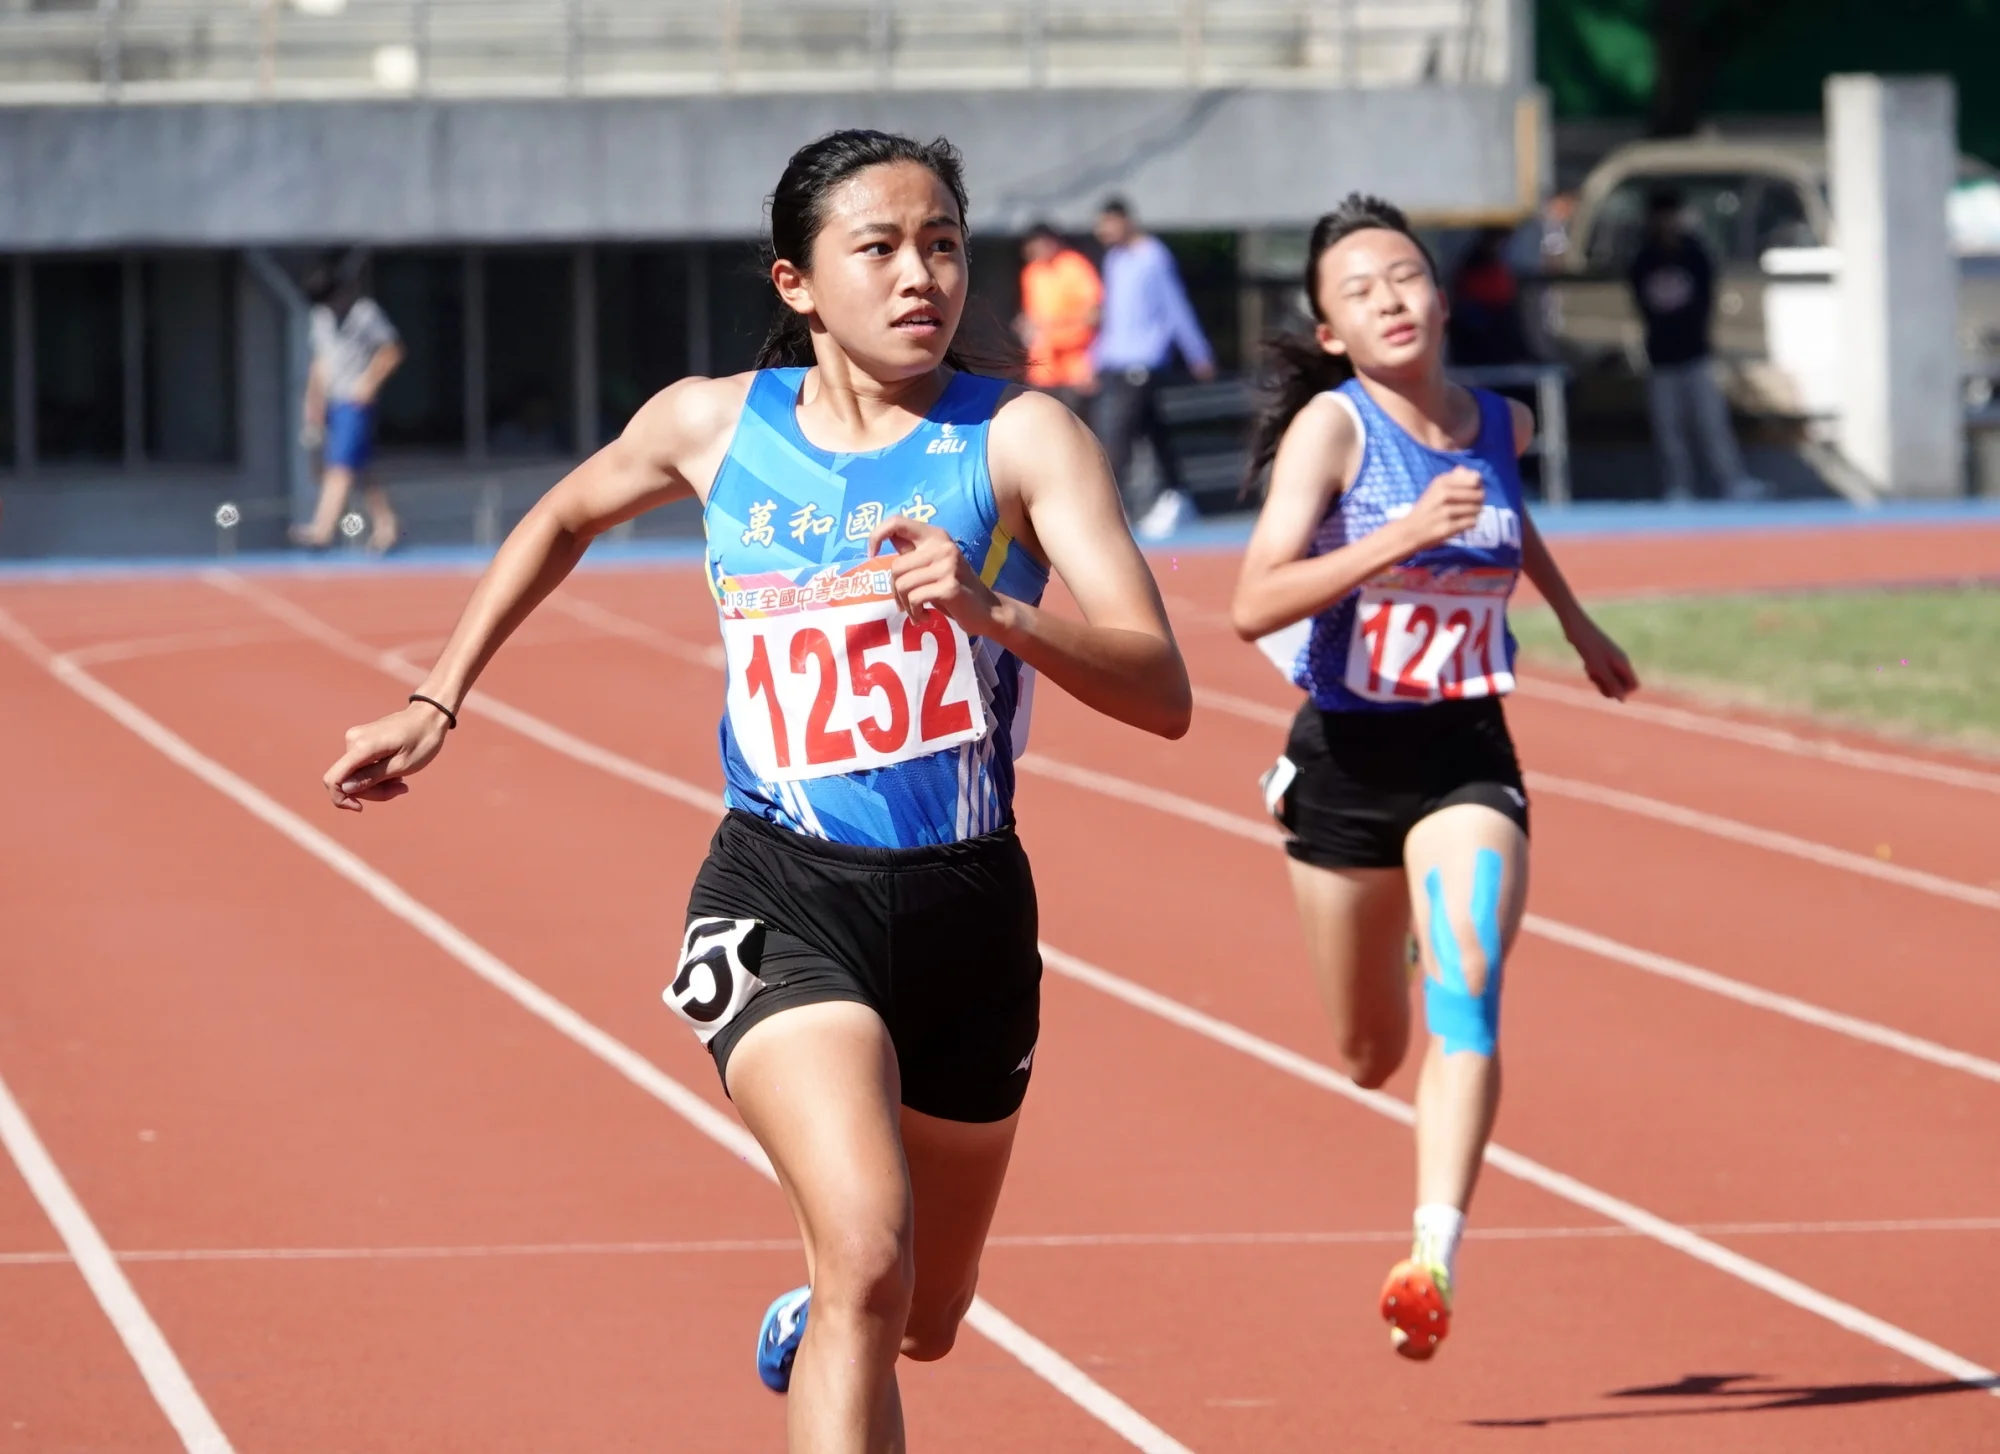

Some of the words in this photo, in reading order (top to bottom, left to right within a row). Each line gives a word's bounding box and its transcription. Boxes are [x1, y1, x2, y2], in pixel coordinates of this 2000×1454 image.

[925, 438, 968, 455] EALI
[740, 494, 938, 548] 萬和國中
[725, 569, 892, 611] 113年全國中等學校田
[745, 608, 974, 768] 1252
[671, 919, 734, 1022] 5
